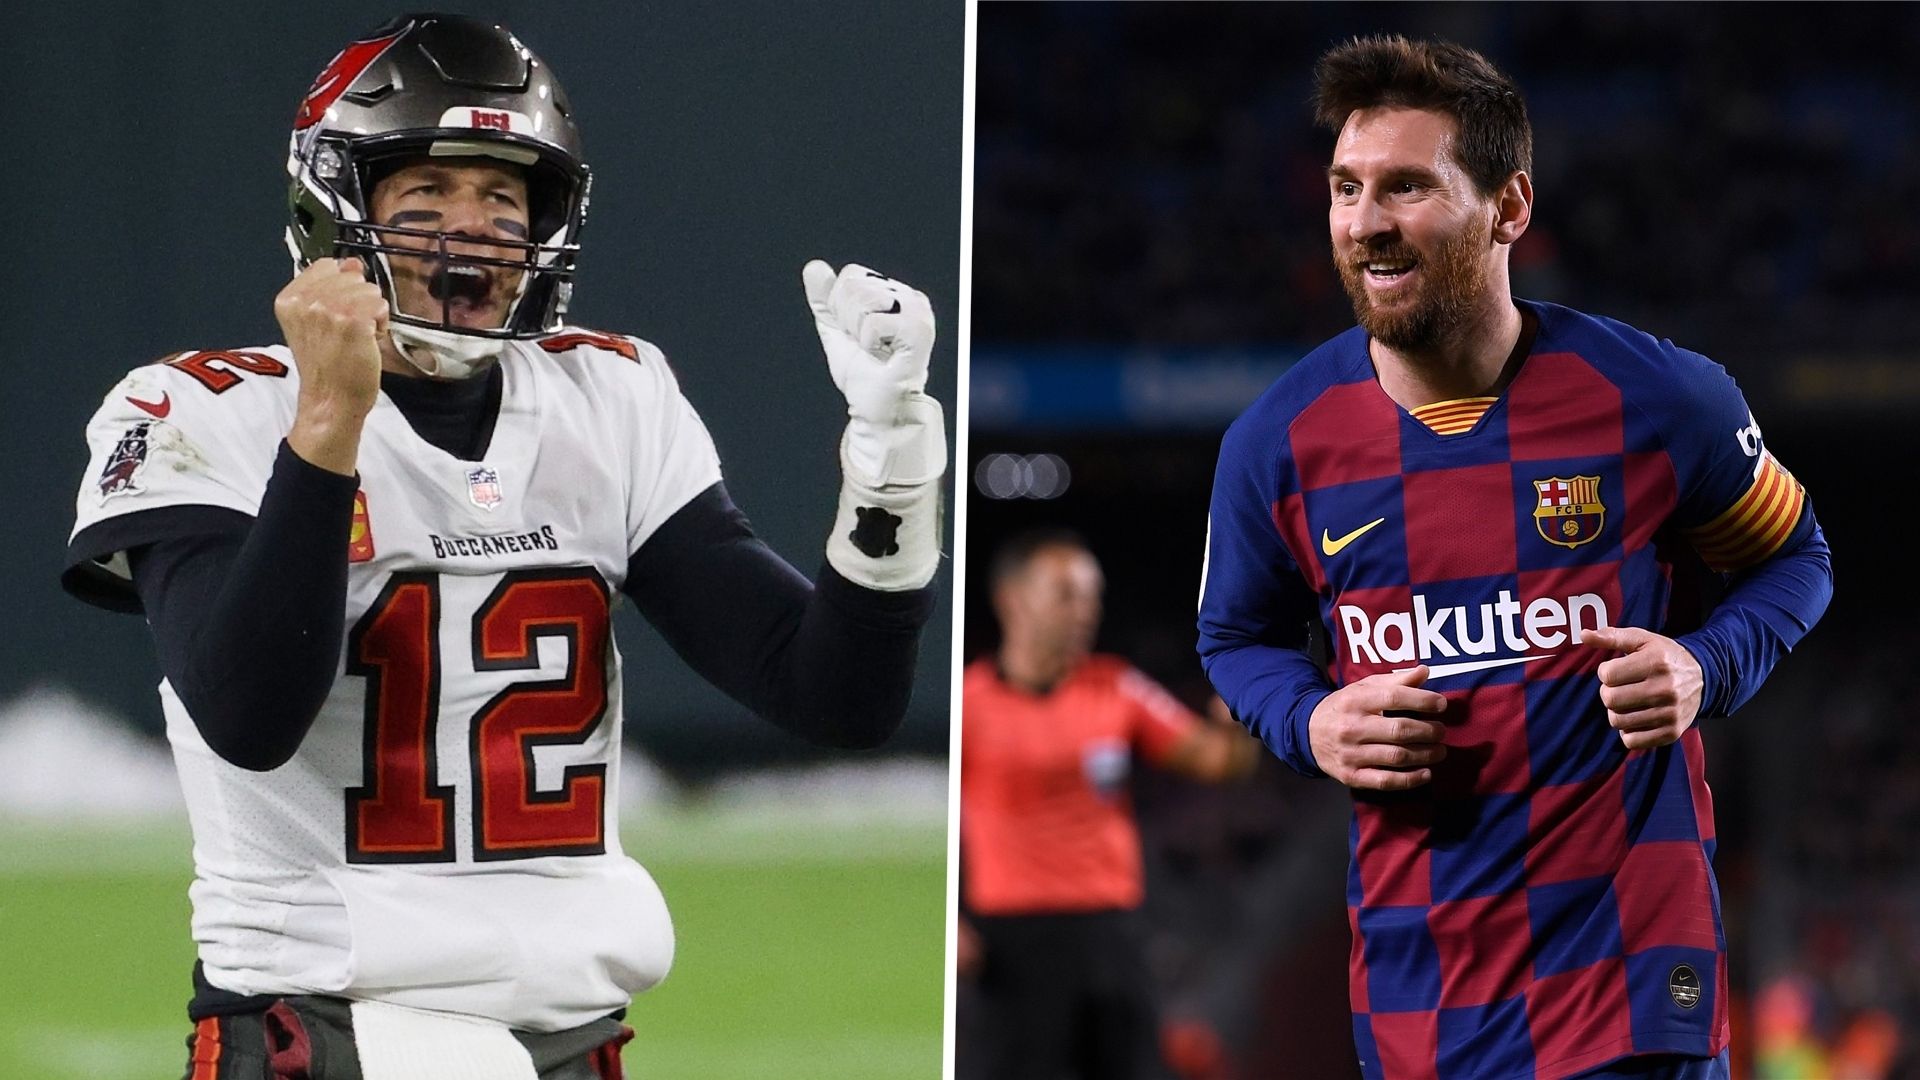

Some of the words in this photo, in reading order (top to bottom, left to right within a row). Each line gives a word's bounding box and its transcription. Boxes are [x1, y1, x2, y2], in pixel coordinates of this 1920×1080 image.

[1555, 505, 1583, 515] FCB
[428, 525, 558, 559] BUCCANEERS
[1339, 590, 1608, 664] Rakuten
[345, 566, 610, 863] 12
